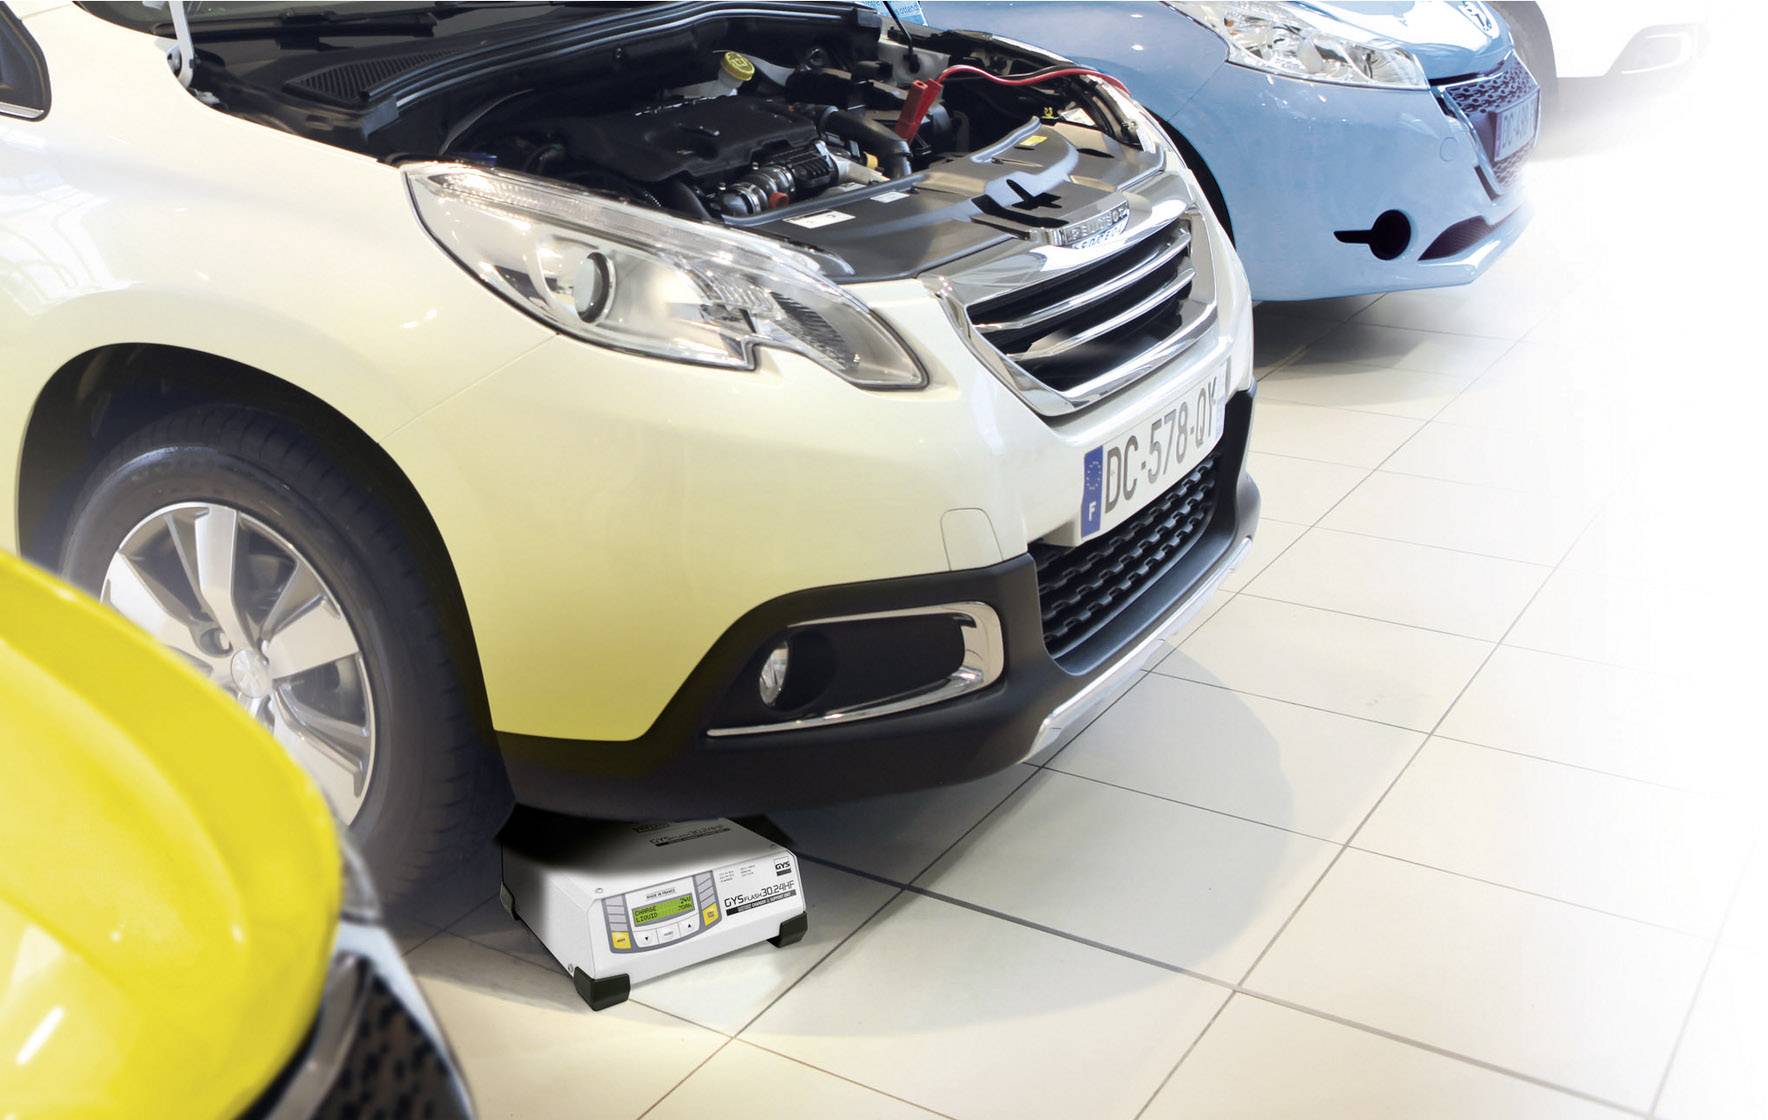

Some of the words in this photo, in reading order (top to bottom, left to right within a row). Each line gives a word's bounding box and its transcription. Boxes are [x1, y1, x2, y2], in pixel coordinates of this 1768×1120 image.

[1104, 376, 1216, 514] DC-578-QY
[1088, 501, 1097, 522] F
[775, 860, 791, 871] GYS
